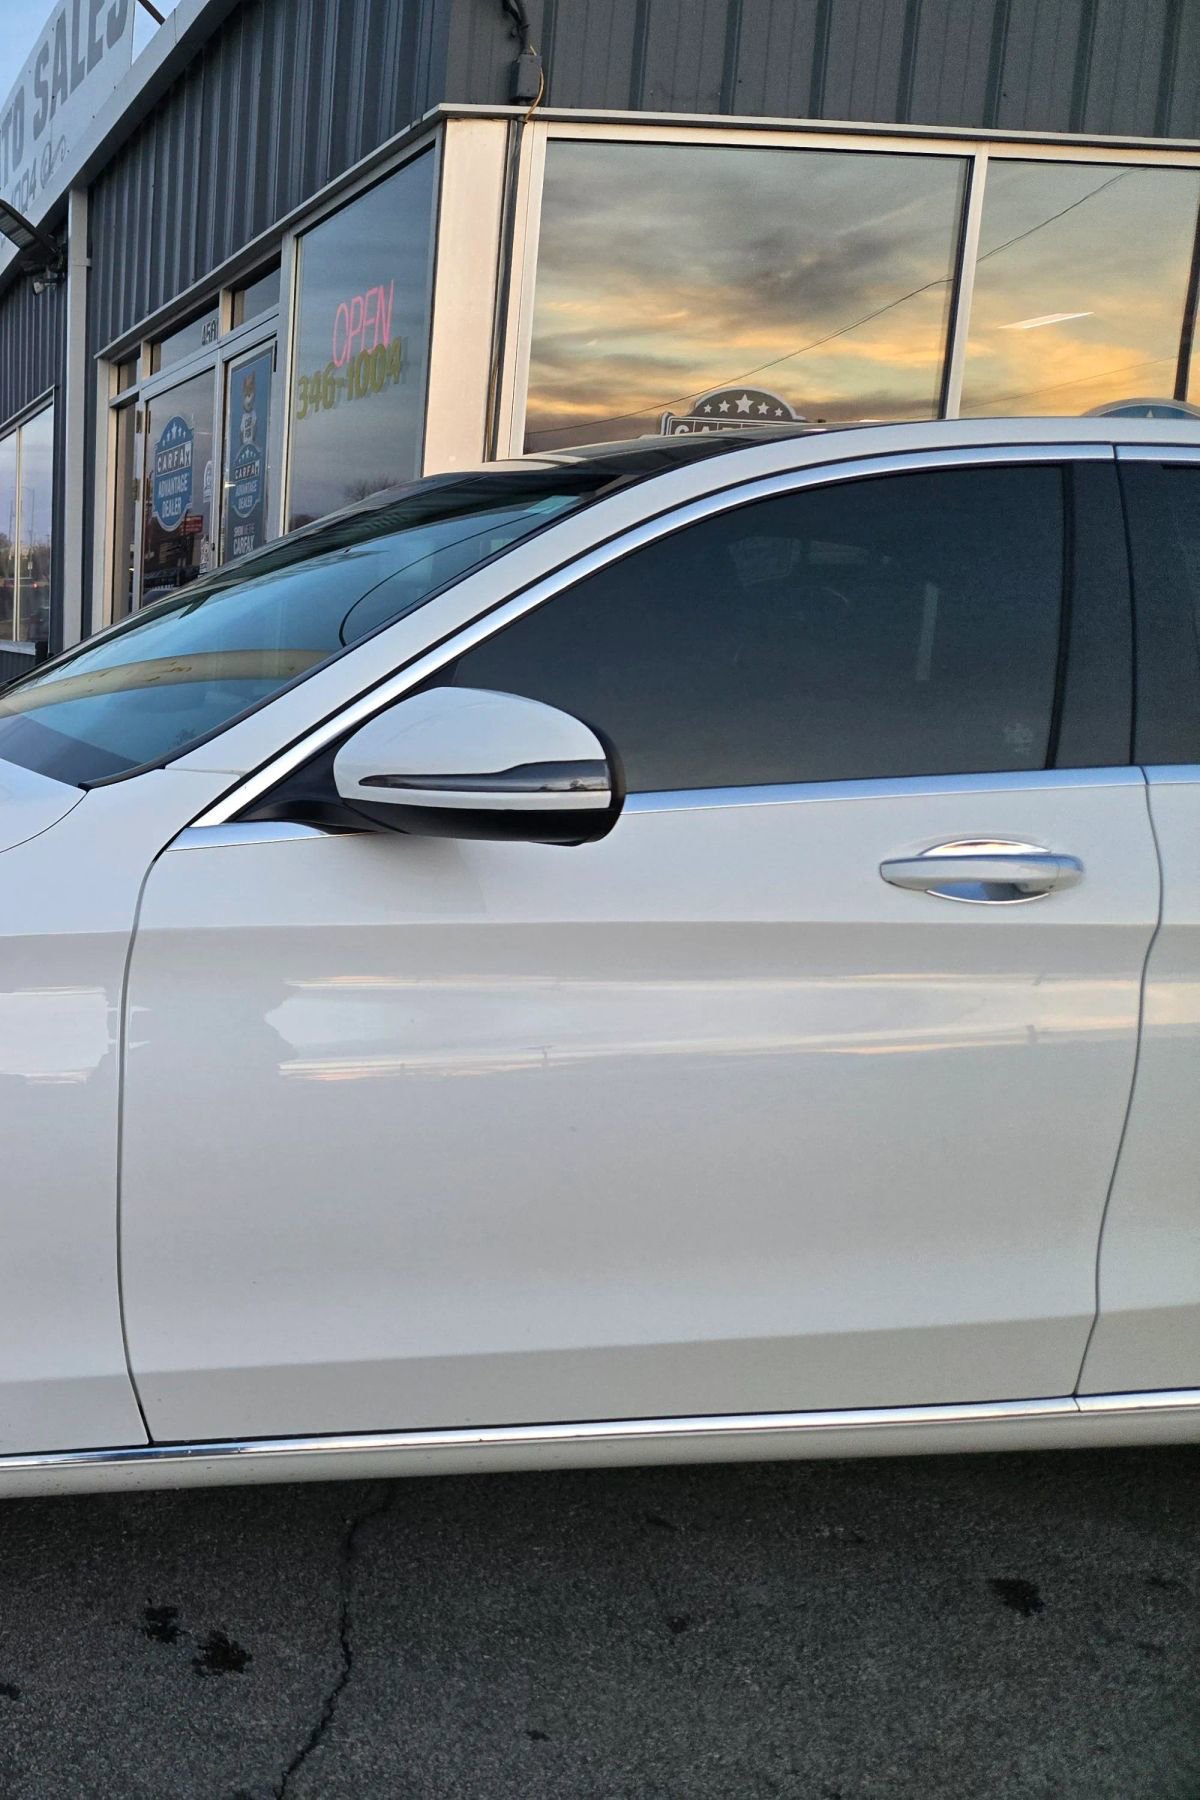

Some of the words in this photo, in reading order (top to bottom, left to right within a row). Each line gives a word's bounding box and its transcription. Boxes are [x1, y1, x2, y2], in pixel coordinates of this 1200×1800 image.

[332, 279, 394, 368] OPEN
[296, 336, 404, 420] 346-1004
[157, 444, 191, 473] CARFAX
[235, 461, 259, 480] CARFAX
[158, 473, 188, 498] ADVANTAGE
[235, 479, 257, 497] ADVANTAGE
[161, 496, 182, 518] DEALER
[238, 495, 253, 511] DEALER
[233, 535, 255, 556] CARFAX
